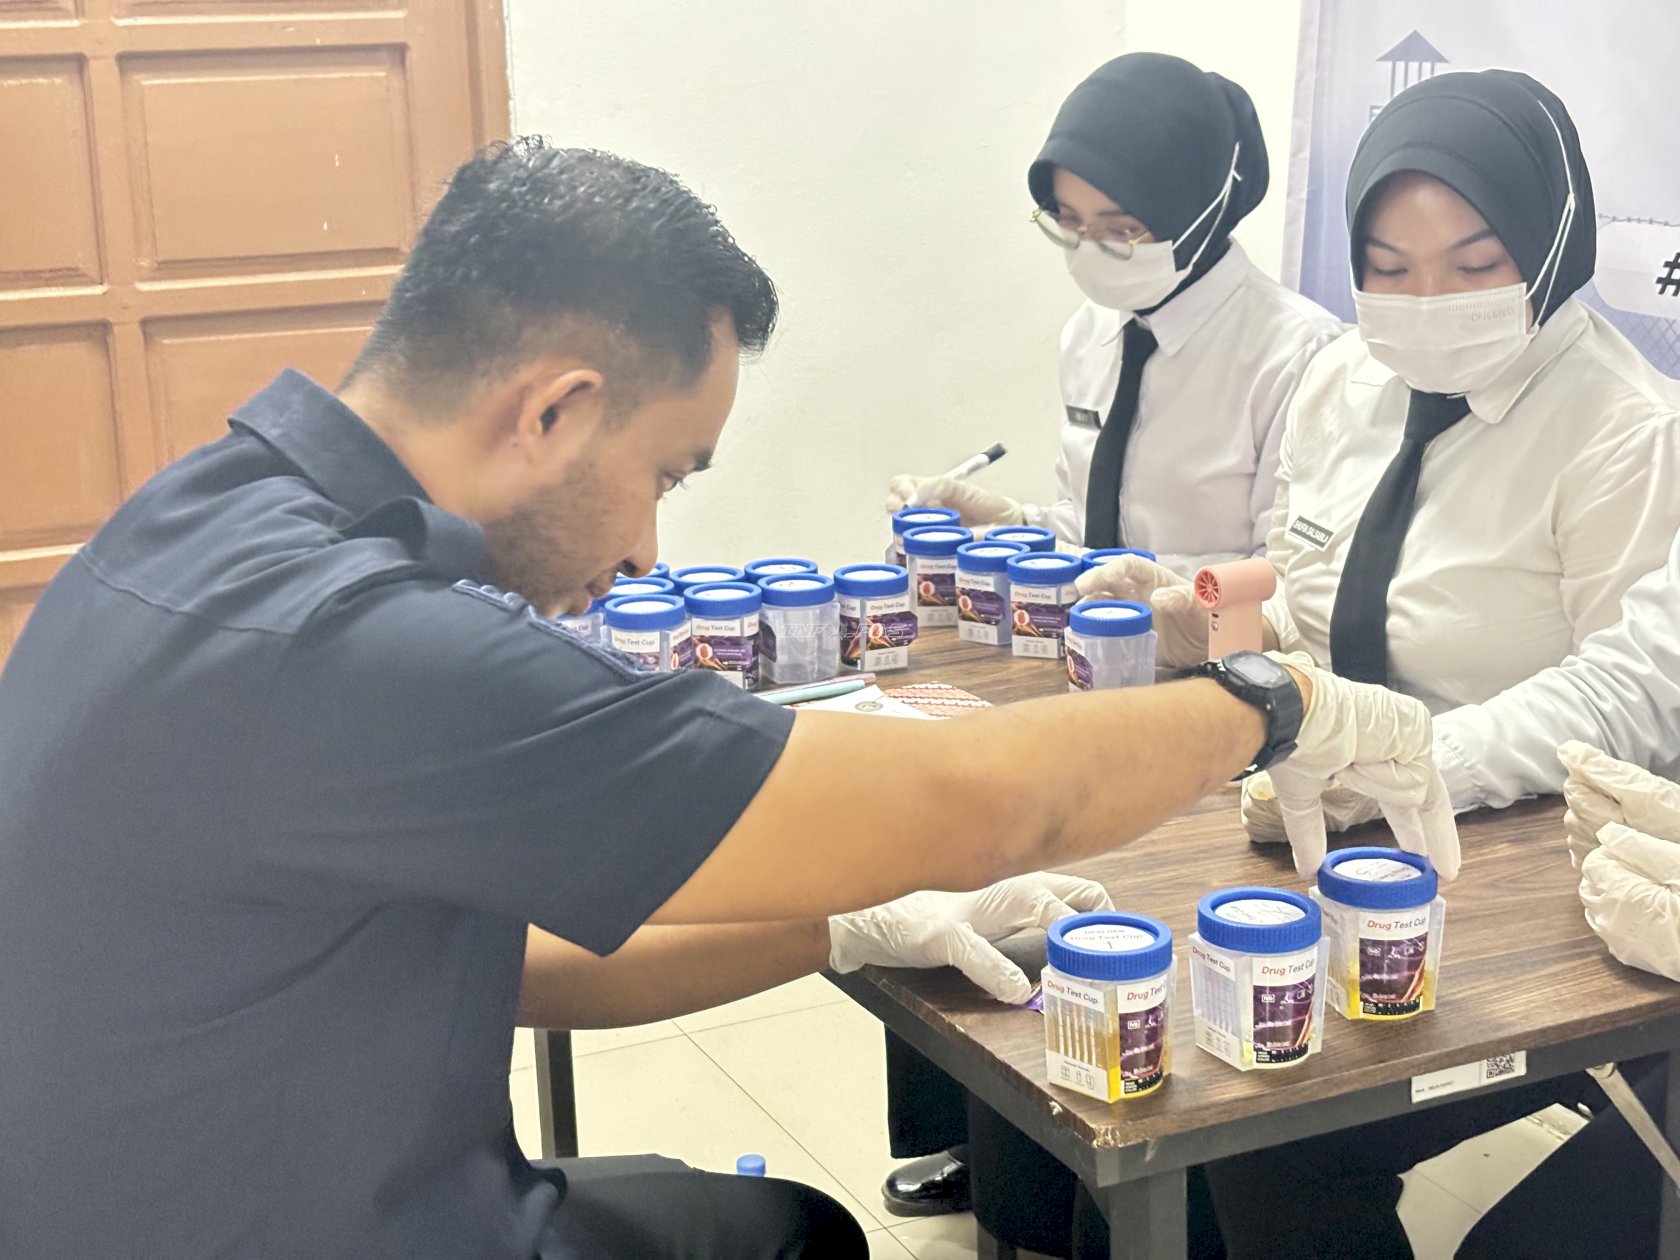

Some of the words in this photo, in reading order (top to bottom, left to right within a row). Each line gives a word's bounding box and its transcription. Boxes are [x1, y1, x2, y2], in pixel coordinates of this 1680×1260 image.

[1367, 919, 1392, 931] Drug
[1394, 920, 1413, 929] Test
[1206, 953, 1218, 966] Test
[1261, 965, 1286, 976] Drug
[1287, 962, 1304, 974] Test
[1047, 980, 1066, 995] Drug
[1066, 985, 1082, 999] Test
[1082, 993, 1098, 1005] Cup
[1126, 991, 1149, 1001] Drug
